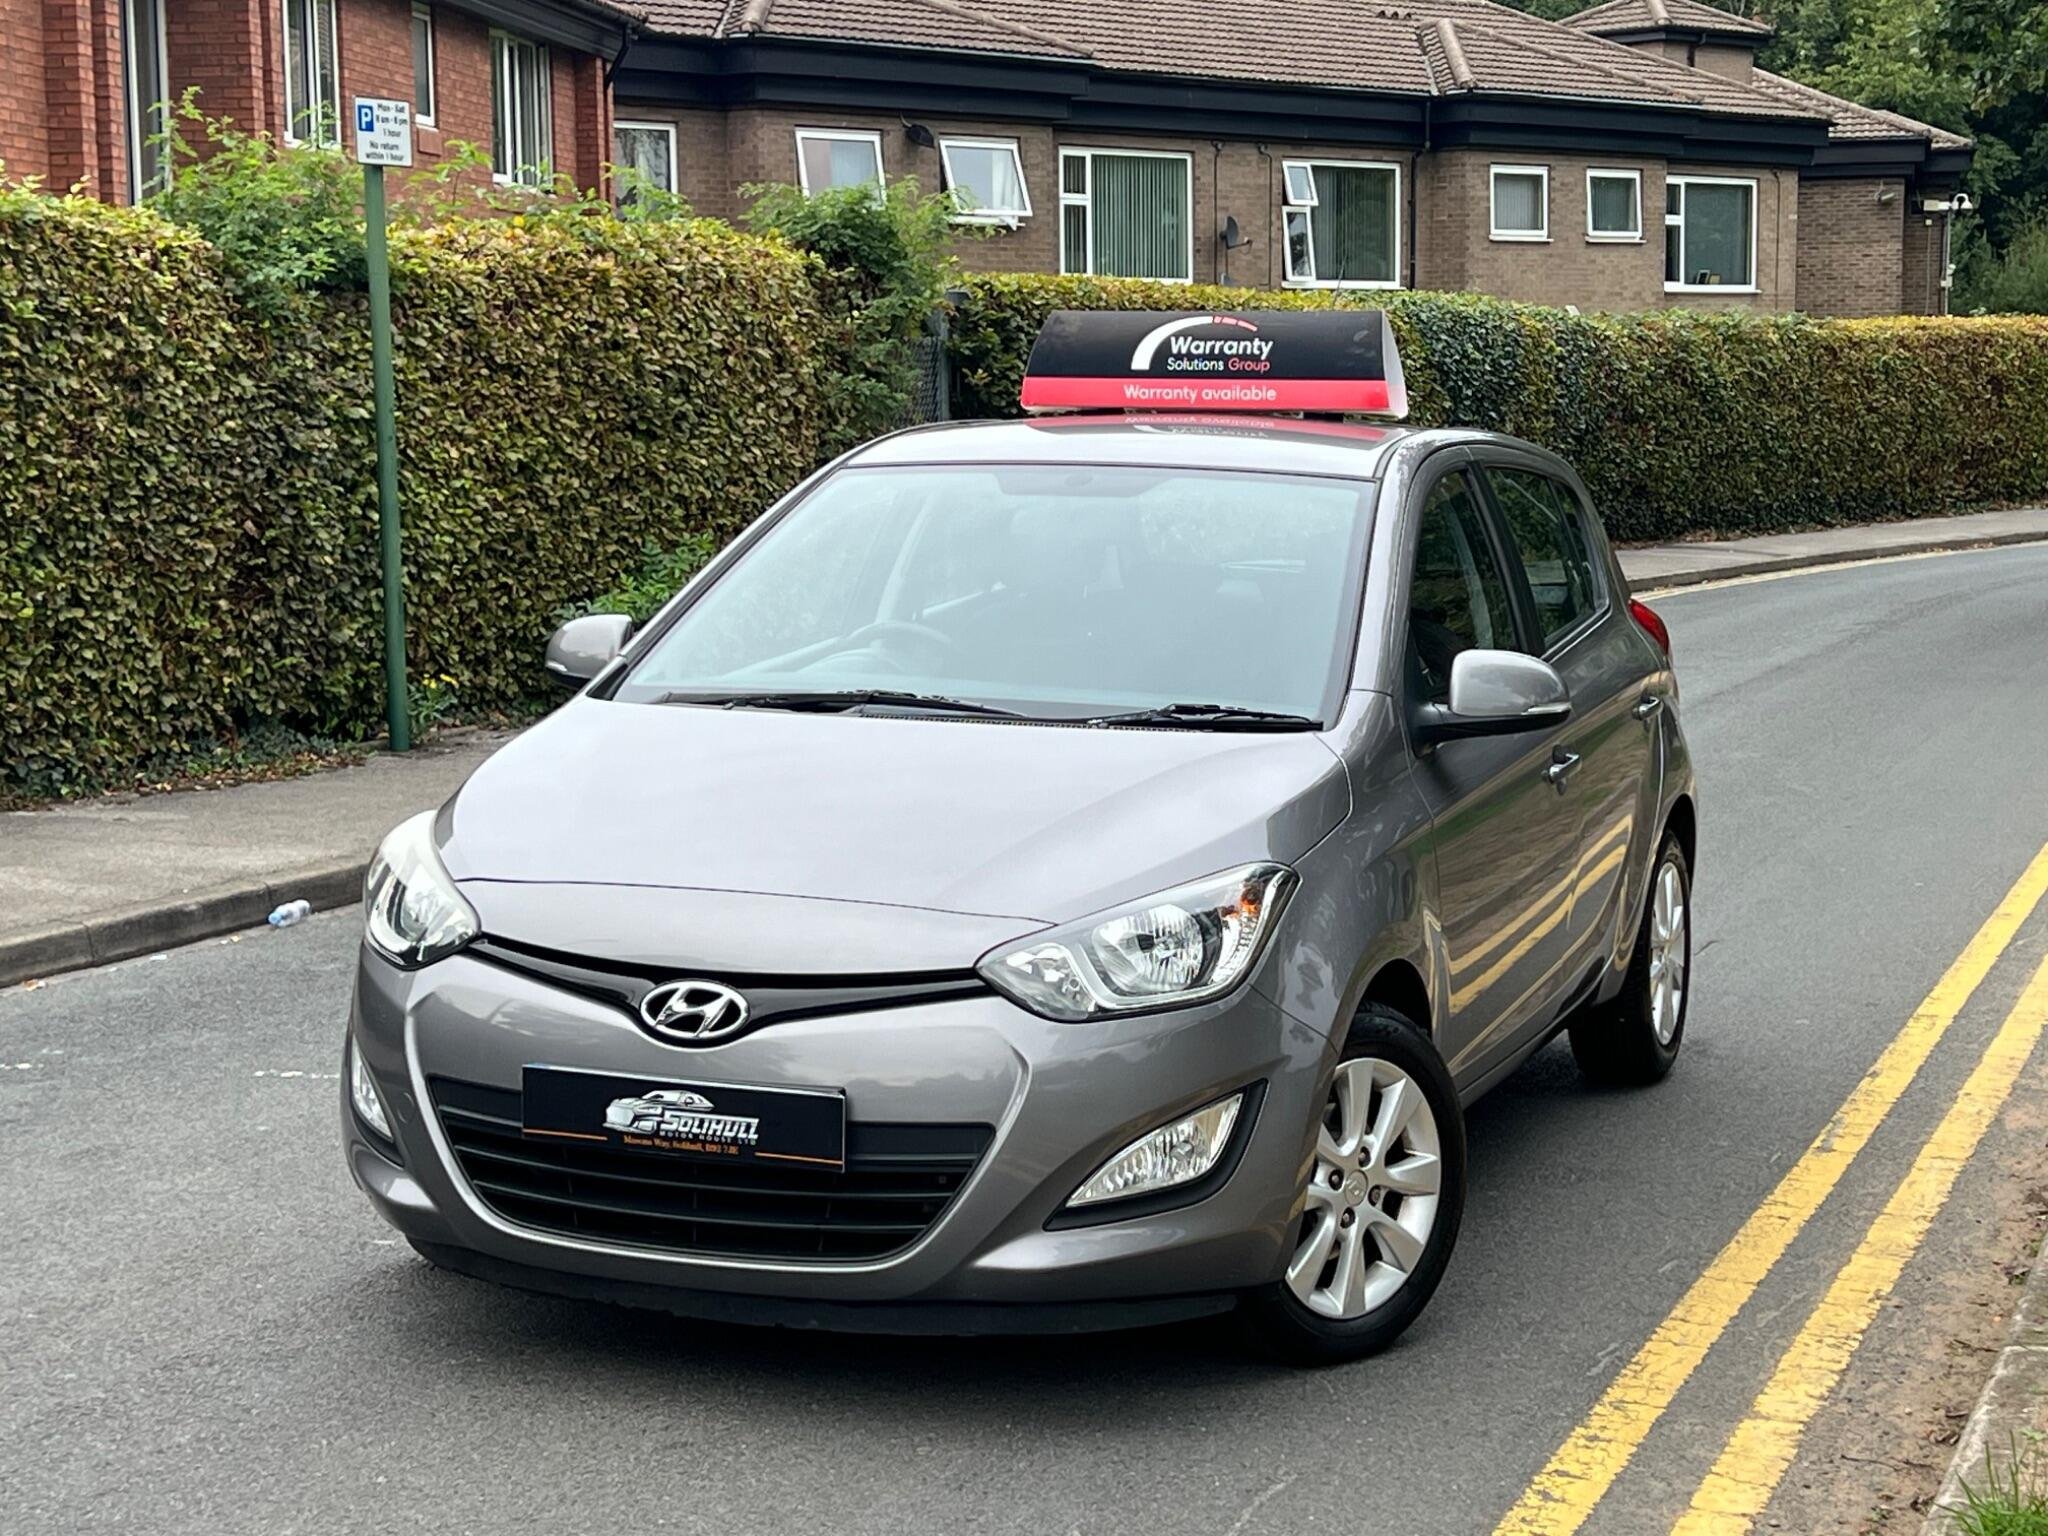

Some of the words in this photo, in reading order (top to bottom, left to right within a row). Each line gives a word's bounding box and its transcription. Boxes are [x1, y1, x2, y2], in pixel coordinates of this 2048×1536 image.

[361, 108, 372, 129] P
[388, 129, 401, 137] hour
[369, 140, 379, 150] No
[380, 142, 399, 150] return
[365, 151, 384, 159] within
[390, 153, 404, 161] hour
[1170, 336, 1273, 360] Warranty
[1167, 357, 1224, 371] Solutions
[1228, 358, 1271, 373] Group
[1123, 384, 1198, 404] Warranty
[1202, 385, 1277, 401] available
[659, 1109, 760, 1139] SOLIHULL
[659, 1130, 694, 1139] MOTOR
[698, 1134, 732, 1143] HOUSE
